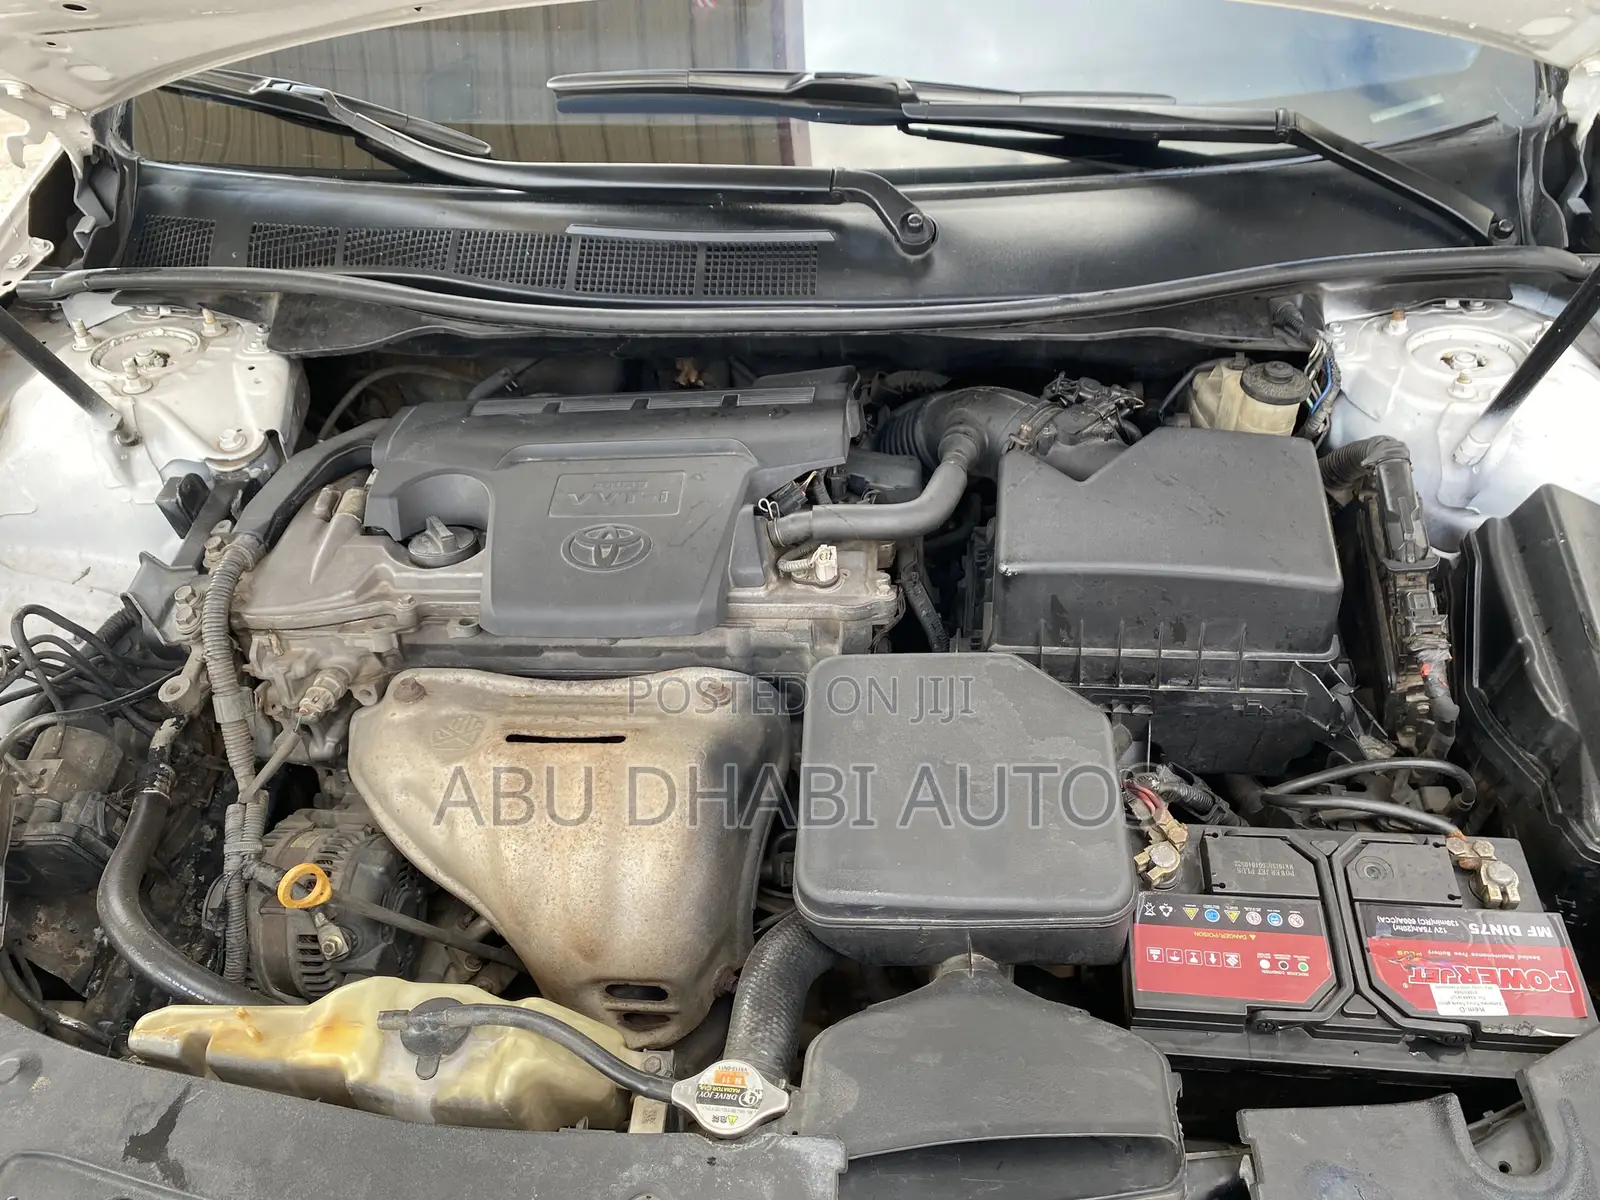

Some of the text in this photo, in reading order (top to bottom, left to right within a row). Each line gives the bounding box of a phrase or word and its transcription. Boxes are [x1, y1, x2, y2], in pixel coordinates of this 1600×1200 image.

[1236, 867, 1255, 875] PLUS
[1392, 923, 1448, 934] 12V 75Ah(20hr)
[1468, 923, 1554, 938] MF DIN75
[1408, 965, 1575, 993] POWERJET
[698, 1091, 738, 1101] DRIVE JOY
